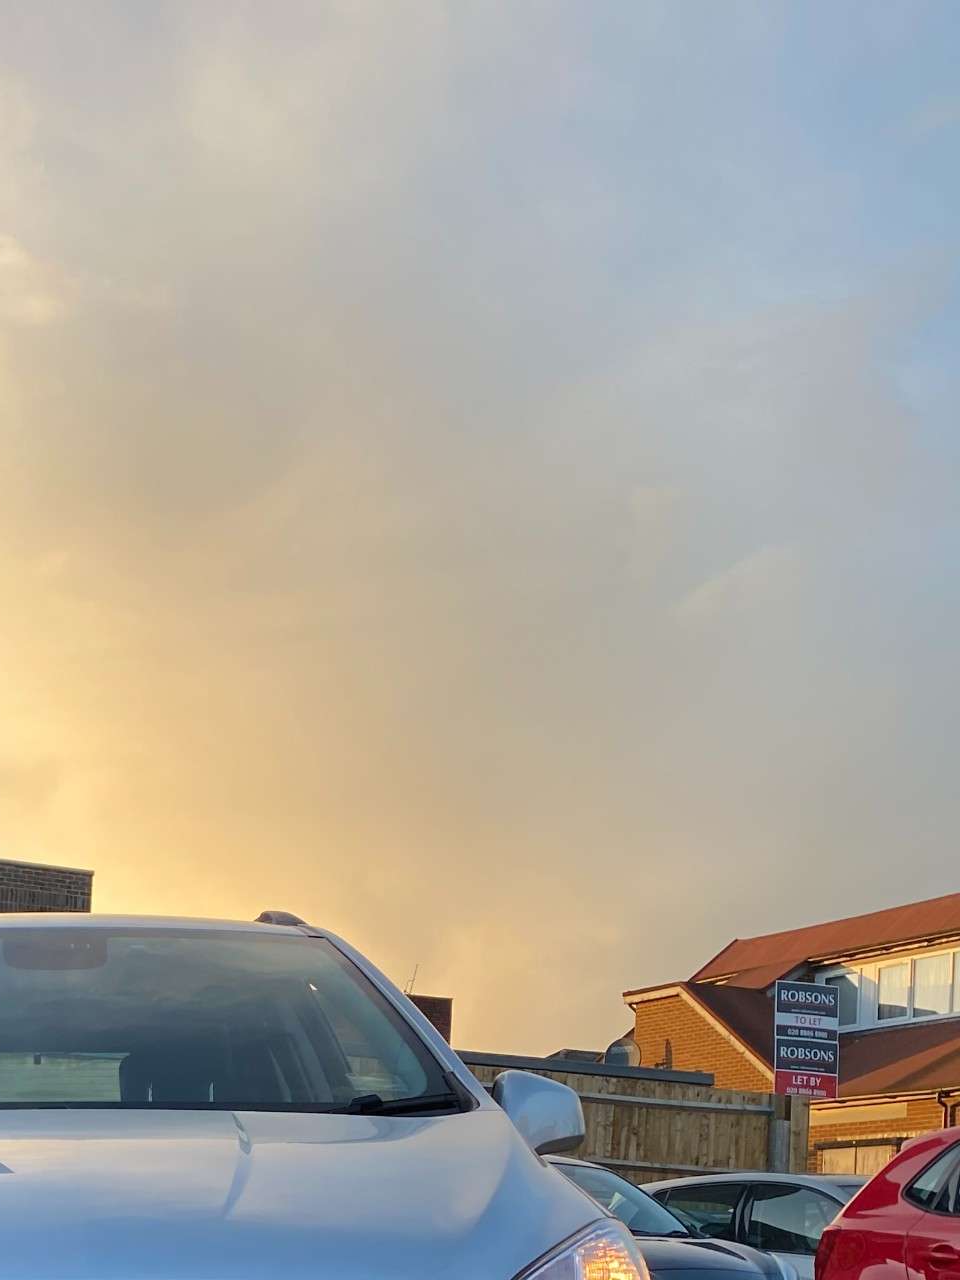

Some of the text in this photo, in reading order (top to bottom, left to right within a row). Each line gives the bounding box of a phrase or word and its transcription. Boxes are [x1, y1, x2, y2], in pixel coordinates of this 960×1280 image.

[781, 989, 835, 1006] ROBSONS
[794, 1016, 806, 1025] TO
[780, 1046, 834, 1062] ROBSONS
[792, 1075, 821, 1087] LET BY
